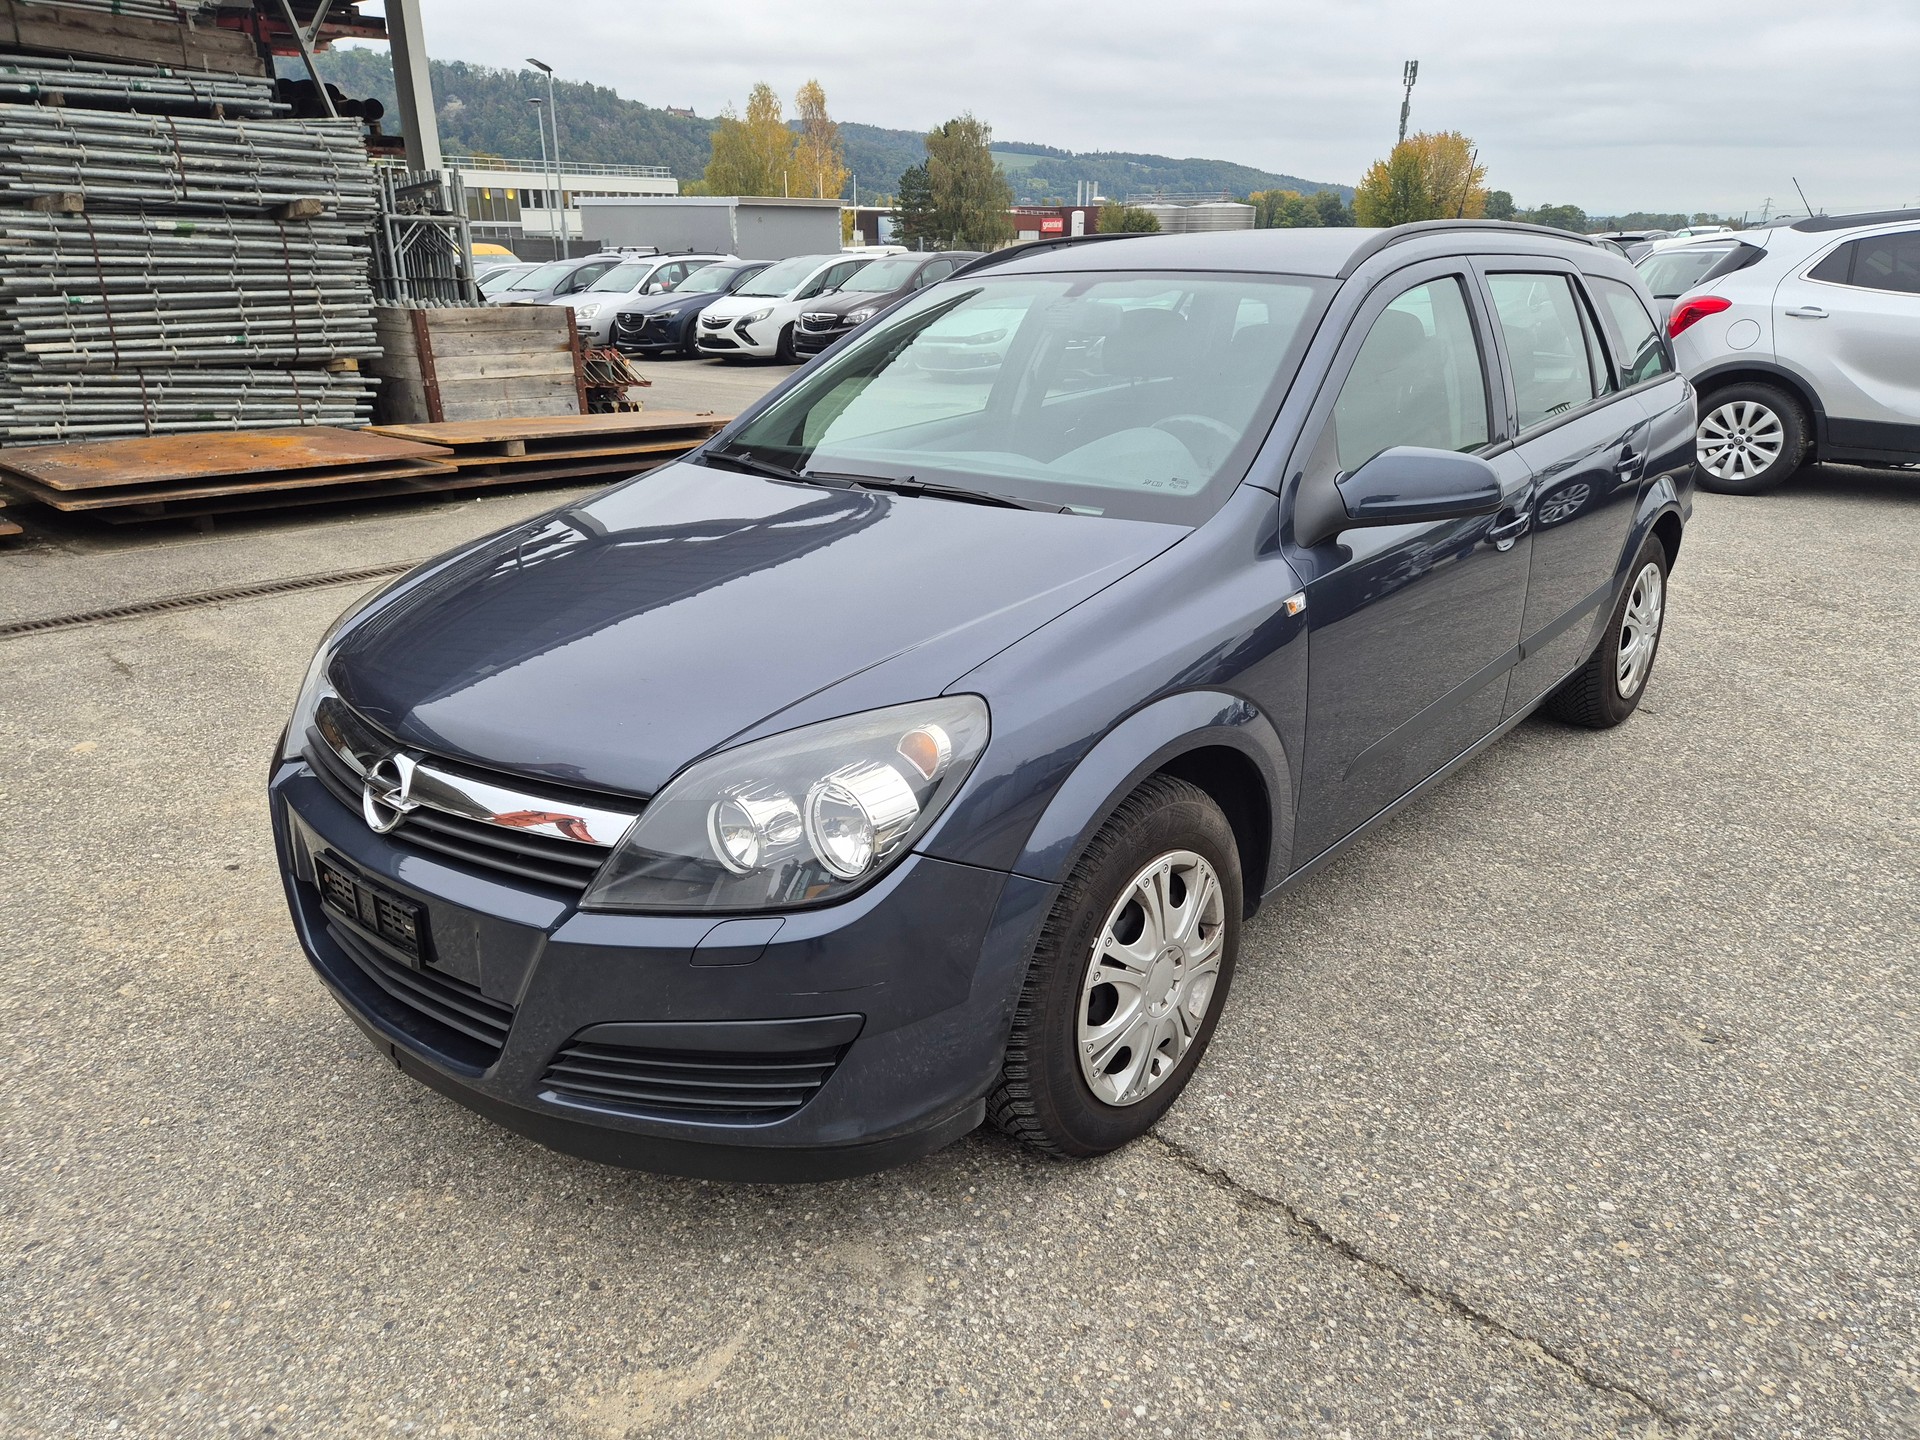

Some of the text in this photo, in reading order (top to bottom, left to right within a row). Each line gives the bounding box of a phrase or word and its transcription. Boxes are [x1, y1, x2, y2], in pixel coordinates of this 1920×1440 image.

[1042, 220, 1062, 230] granini
[1068, 939, 1082, 958] TS
[1076, 907, 1094, 940] 860
